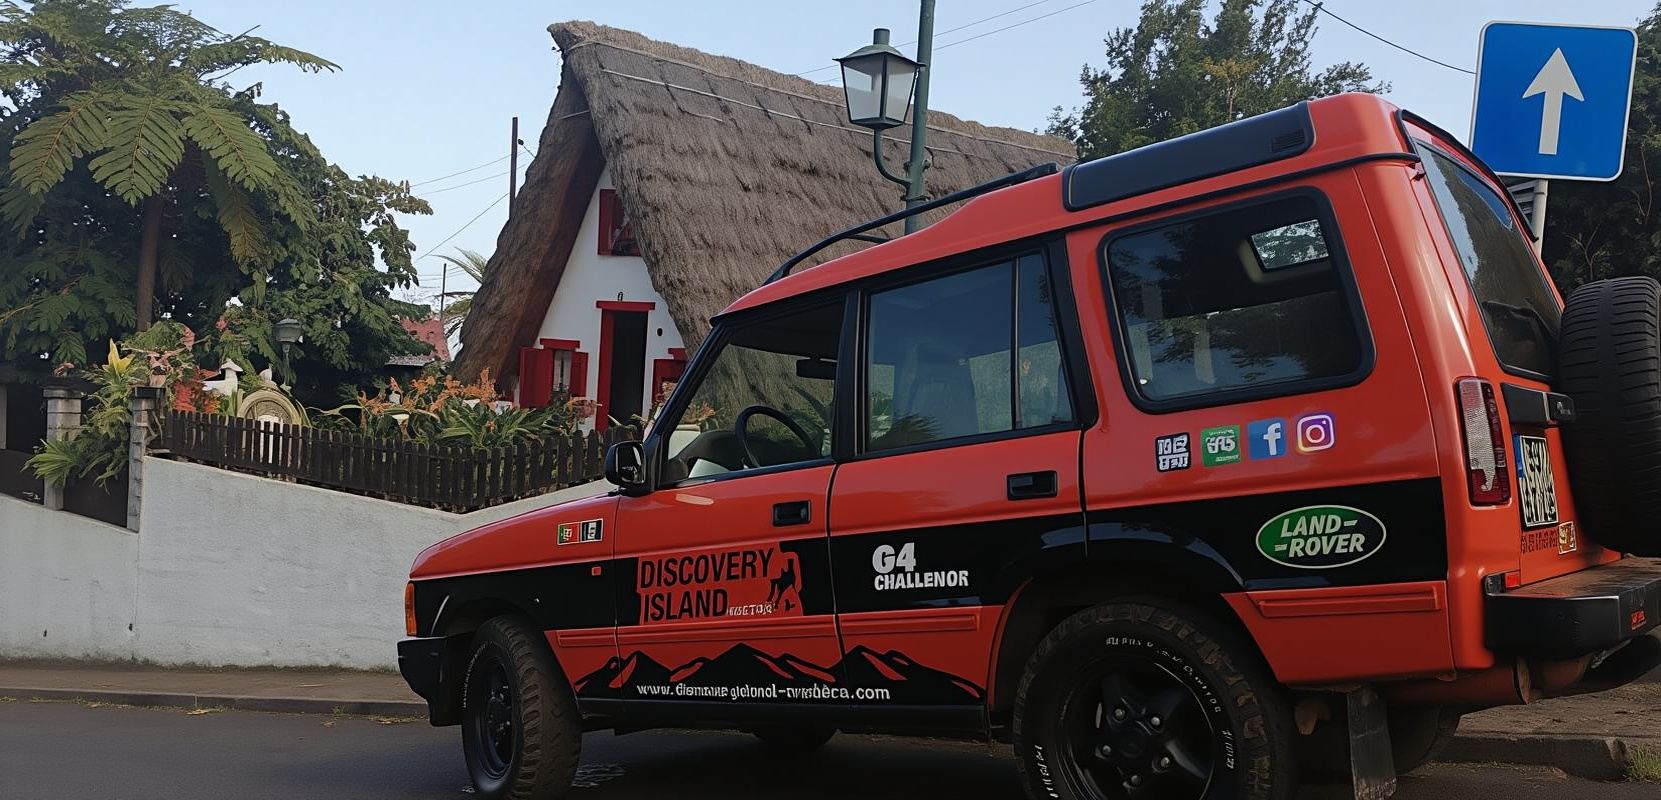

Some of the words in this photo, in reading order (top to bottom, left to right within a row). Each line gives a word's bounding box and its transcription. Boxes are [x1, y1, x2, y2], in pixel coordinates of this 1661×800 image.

[640, 547, 774, 589] DISCOVERY
[872, 542, 916, 574] G4
[874, 570, 969, 591] CHALLENOR
[643, 588, 728, 622] ISLAND
